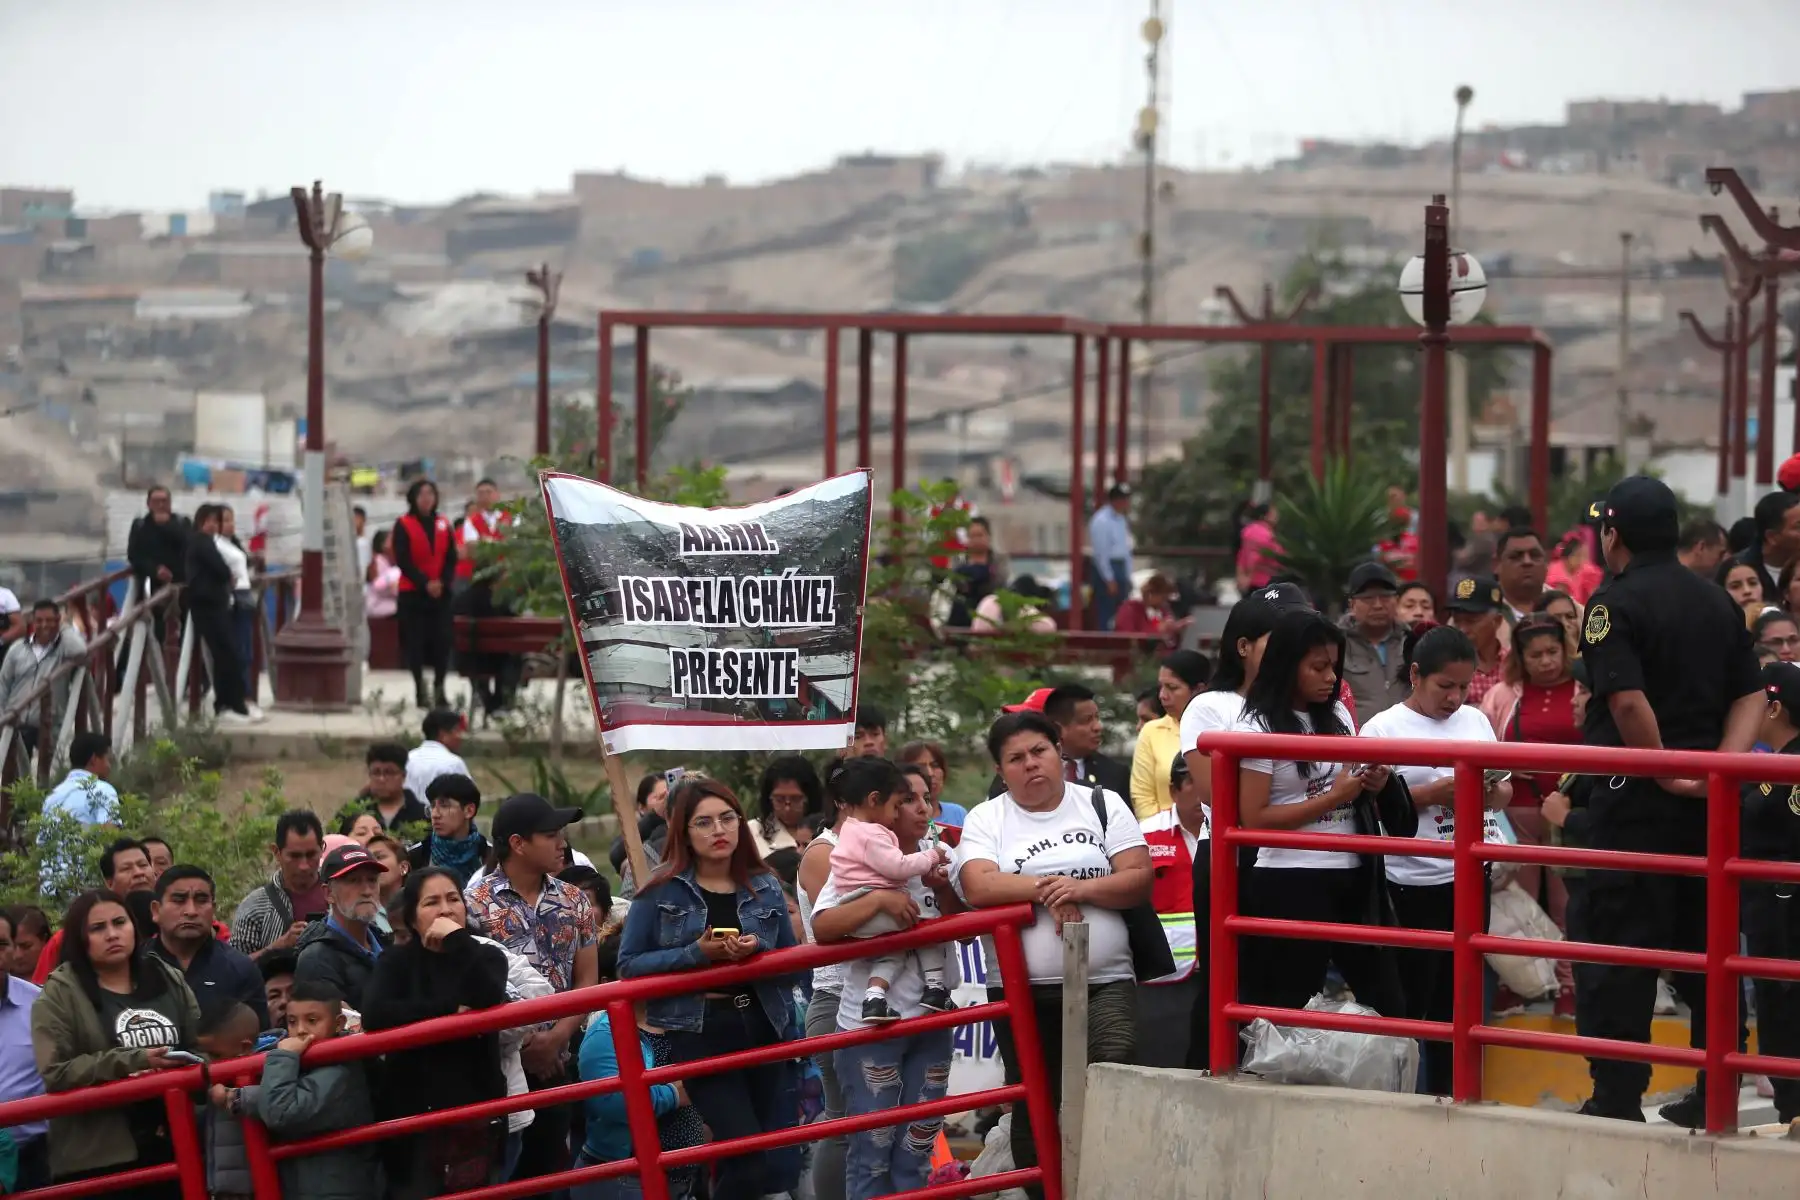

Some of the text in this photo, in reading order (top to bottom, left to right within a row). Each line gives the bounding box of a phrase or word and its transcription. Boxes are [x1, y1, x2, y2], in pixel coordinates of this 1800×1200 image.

[680, 522, 778, 553] AA.HH.
[620, 571, 834, 625] ISABELA CHÁVEZ
[671, 650, 798, 697] PRESENTE
[1013, 838, 1058, 874] A.HH.
